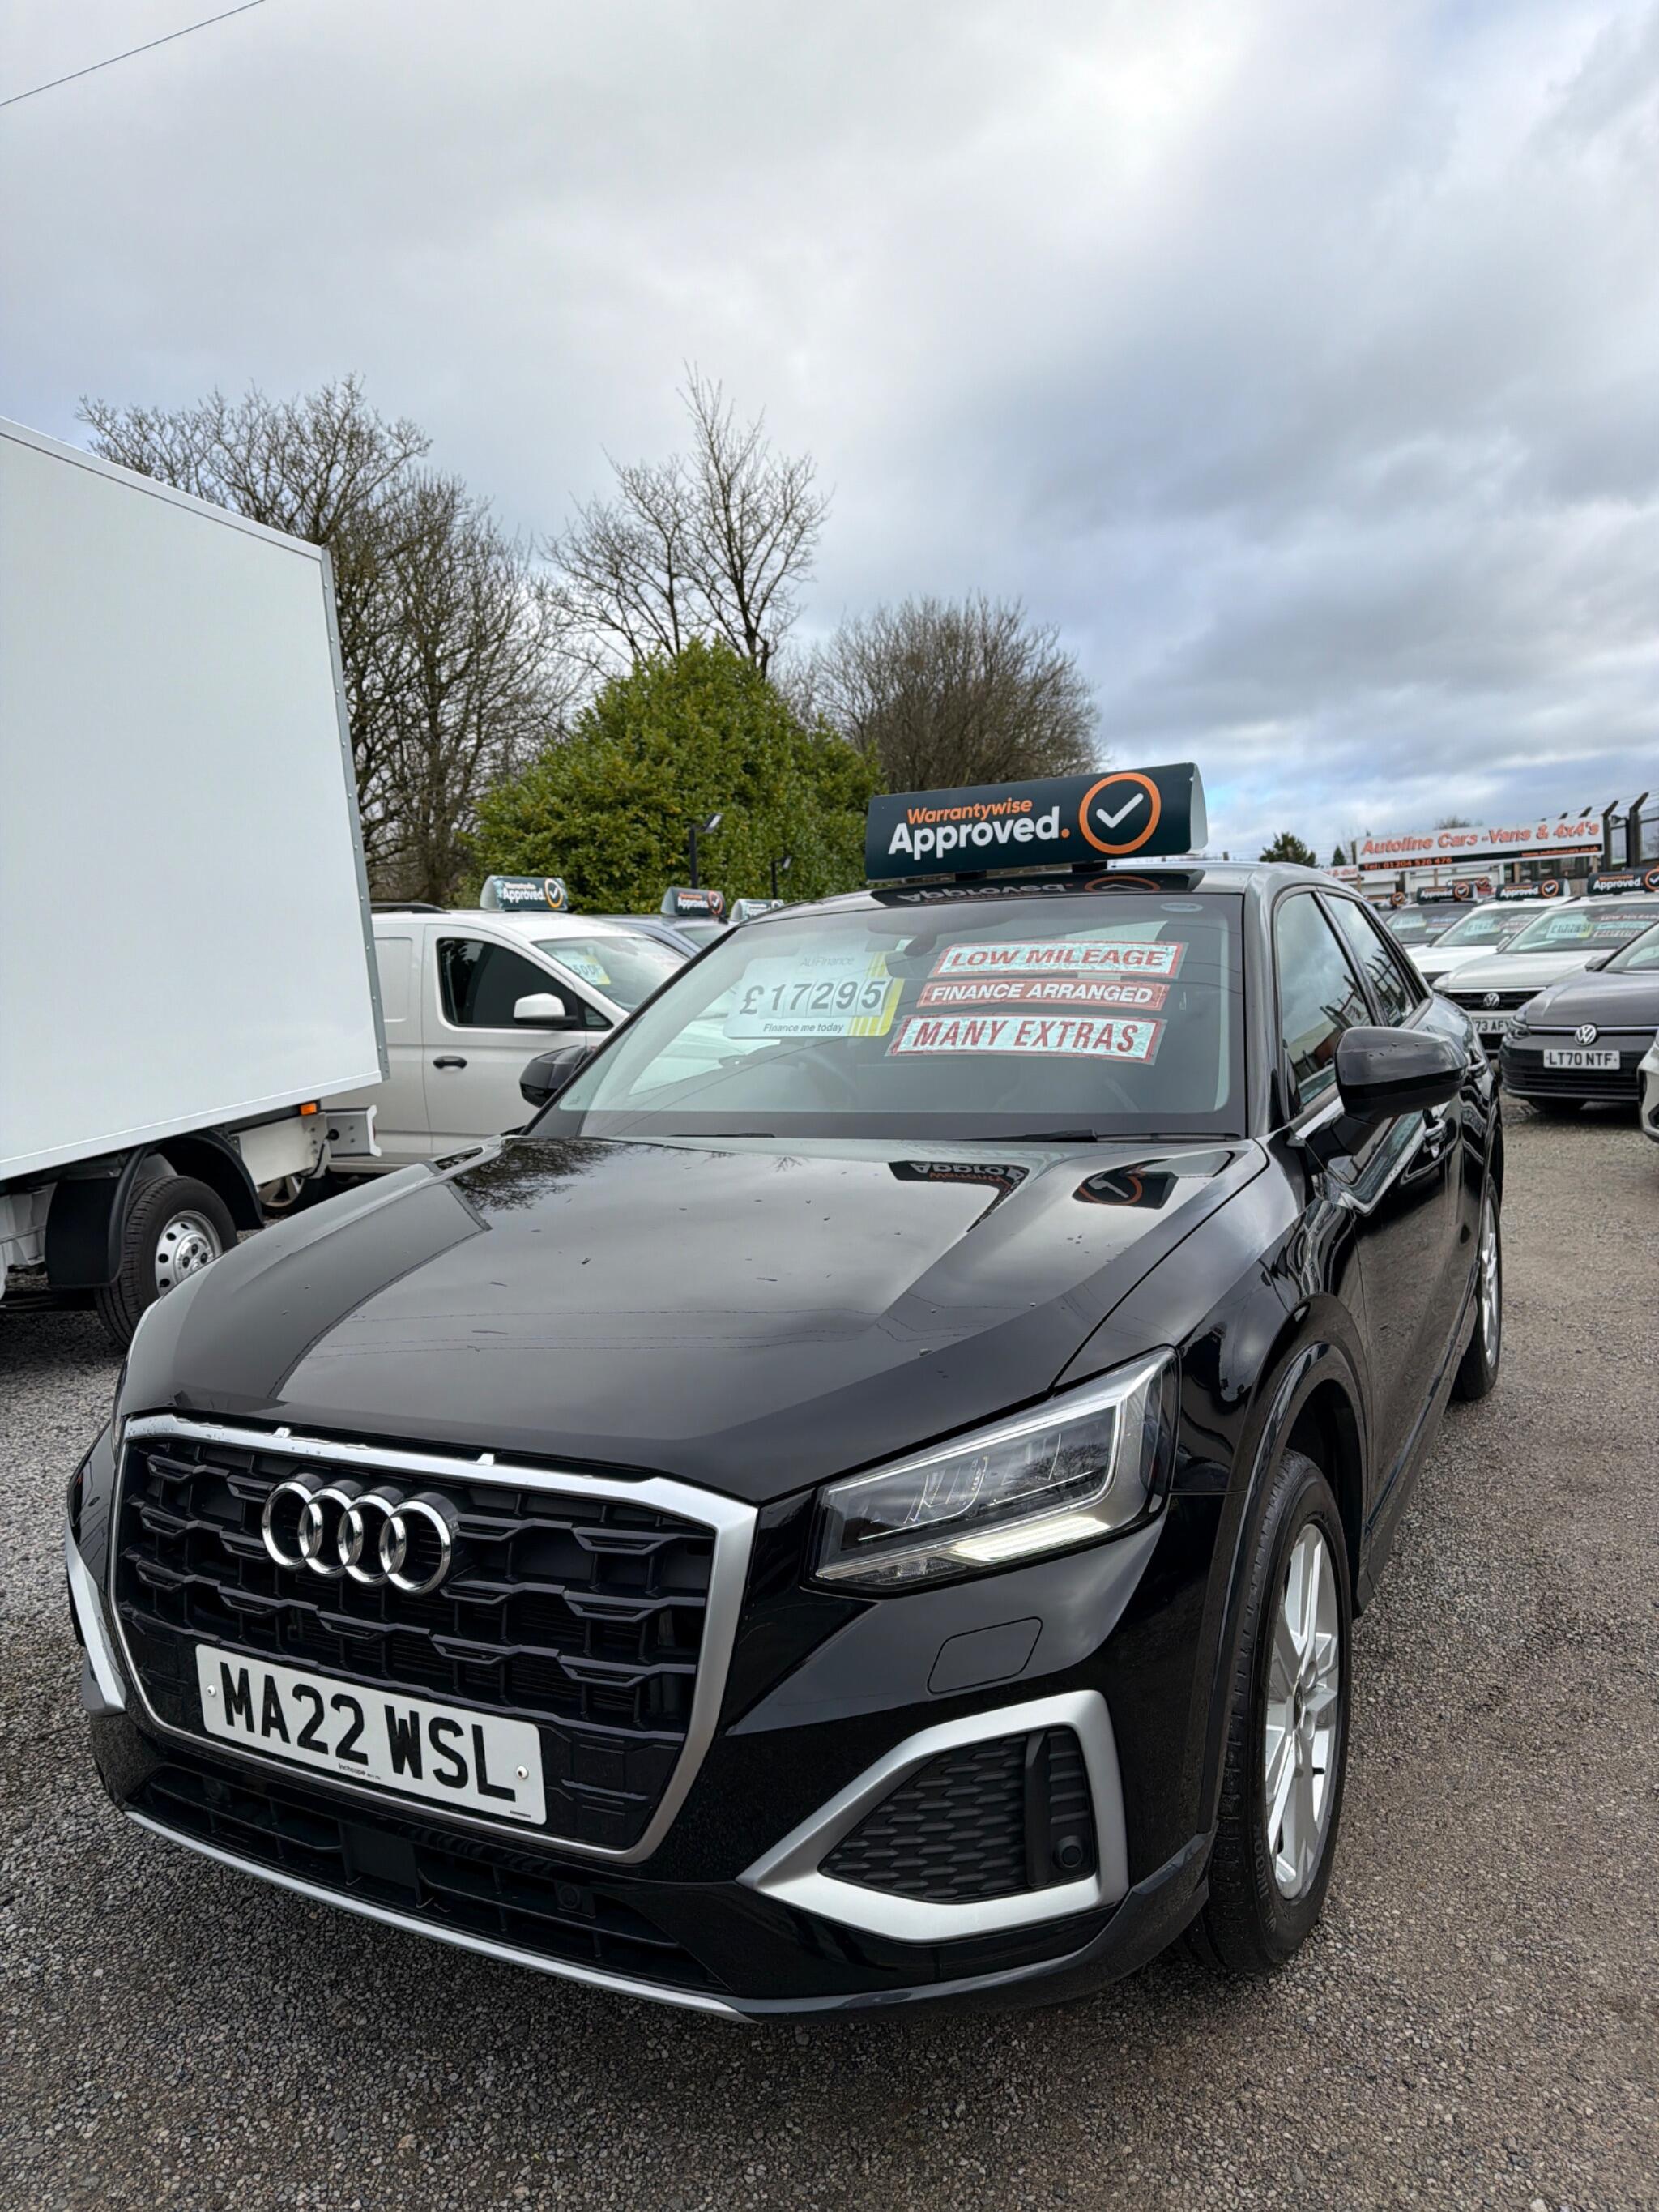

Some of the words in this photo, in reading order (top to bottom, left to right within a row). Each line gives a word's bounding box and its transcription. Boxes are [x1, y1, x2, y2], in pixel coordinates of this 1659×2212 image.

[907, 797, 1033, 825] Warrantywise
[888, 805, 1070, 860] Approved.
[1361, 836, 1433, 855] Autoline
[1438, 832, 1478, 848] Cars
[1536, 824, 1549, 839] &
[951, 950, 1019, 966] LOW
[1025, 949, 1166, 966] MILEAGE
[740, 980, 886, 1014] £17295
[930, 983, 1024, 1001] FINANCE
[1026, 983, 1153, 1003] ARRANGED
[762, 1023, 799, 1032] Finance
[817, 1023, 844, 1034] today
[912, 1020, 1009, 1048] MANY
[1013, 1020, 1138, 1052] EXTRAS
[1549, 1053, 1580, 1065] LT70
[1586, 1053, 1612, 1065] NTF
[220, 1661, 369, 1766] MA22
[384, 1704, 516, 1803] WSL
